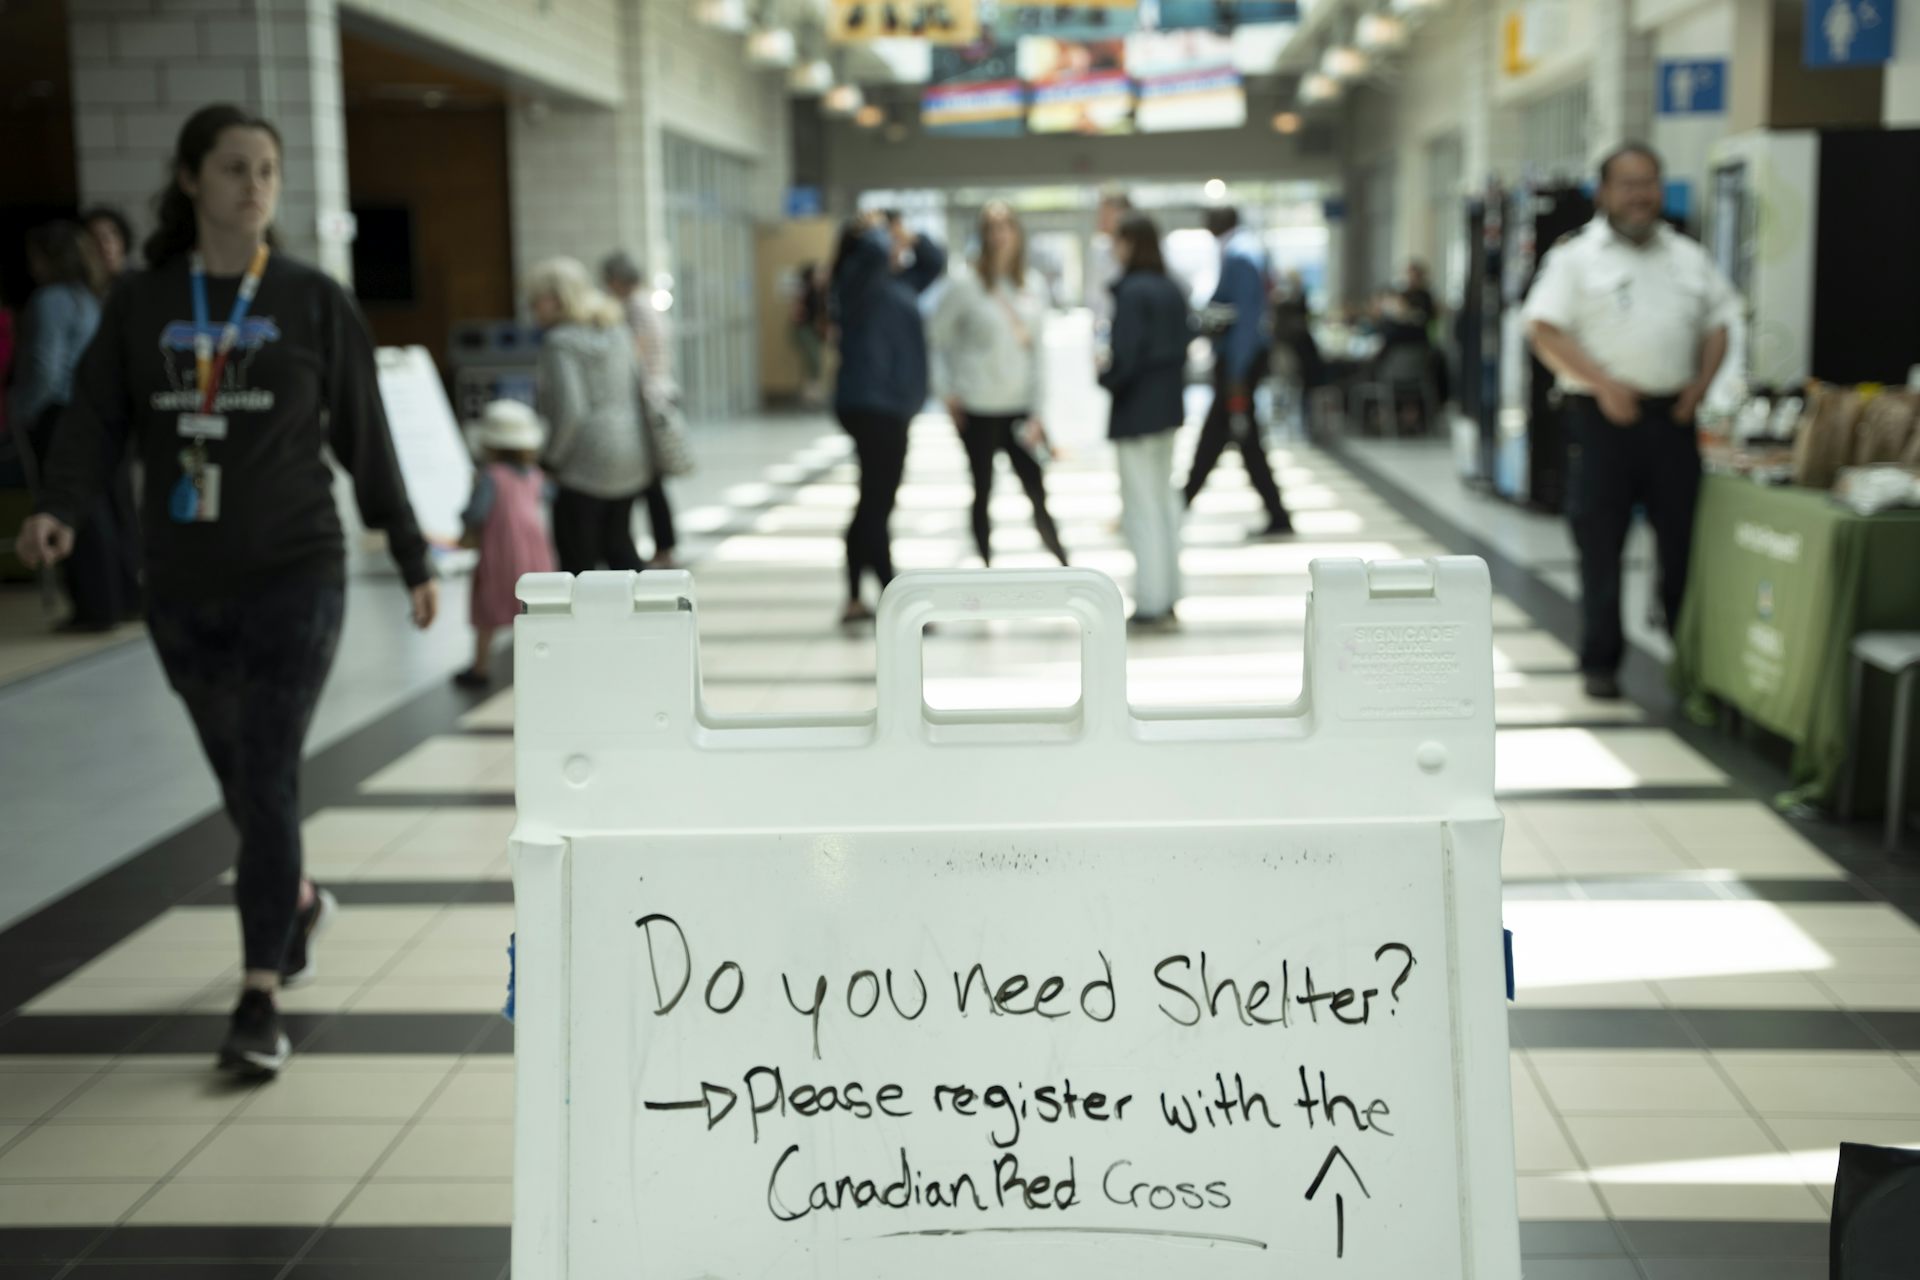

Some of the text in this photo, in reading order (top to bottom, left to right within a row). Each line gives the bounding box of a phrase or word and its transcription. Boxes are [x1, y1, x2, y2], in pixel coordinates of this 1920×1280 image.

[634, 912, 1418, 1061] Do you need Shelter?
[932, 1078, 1134, 1150] register
[1159, 1072, 1282, 1135] with
[1294, 1064, 1396, 1137] the
[766, 1144, 1232, 1223] Canadian Red Cross
